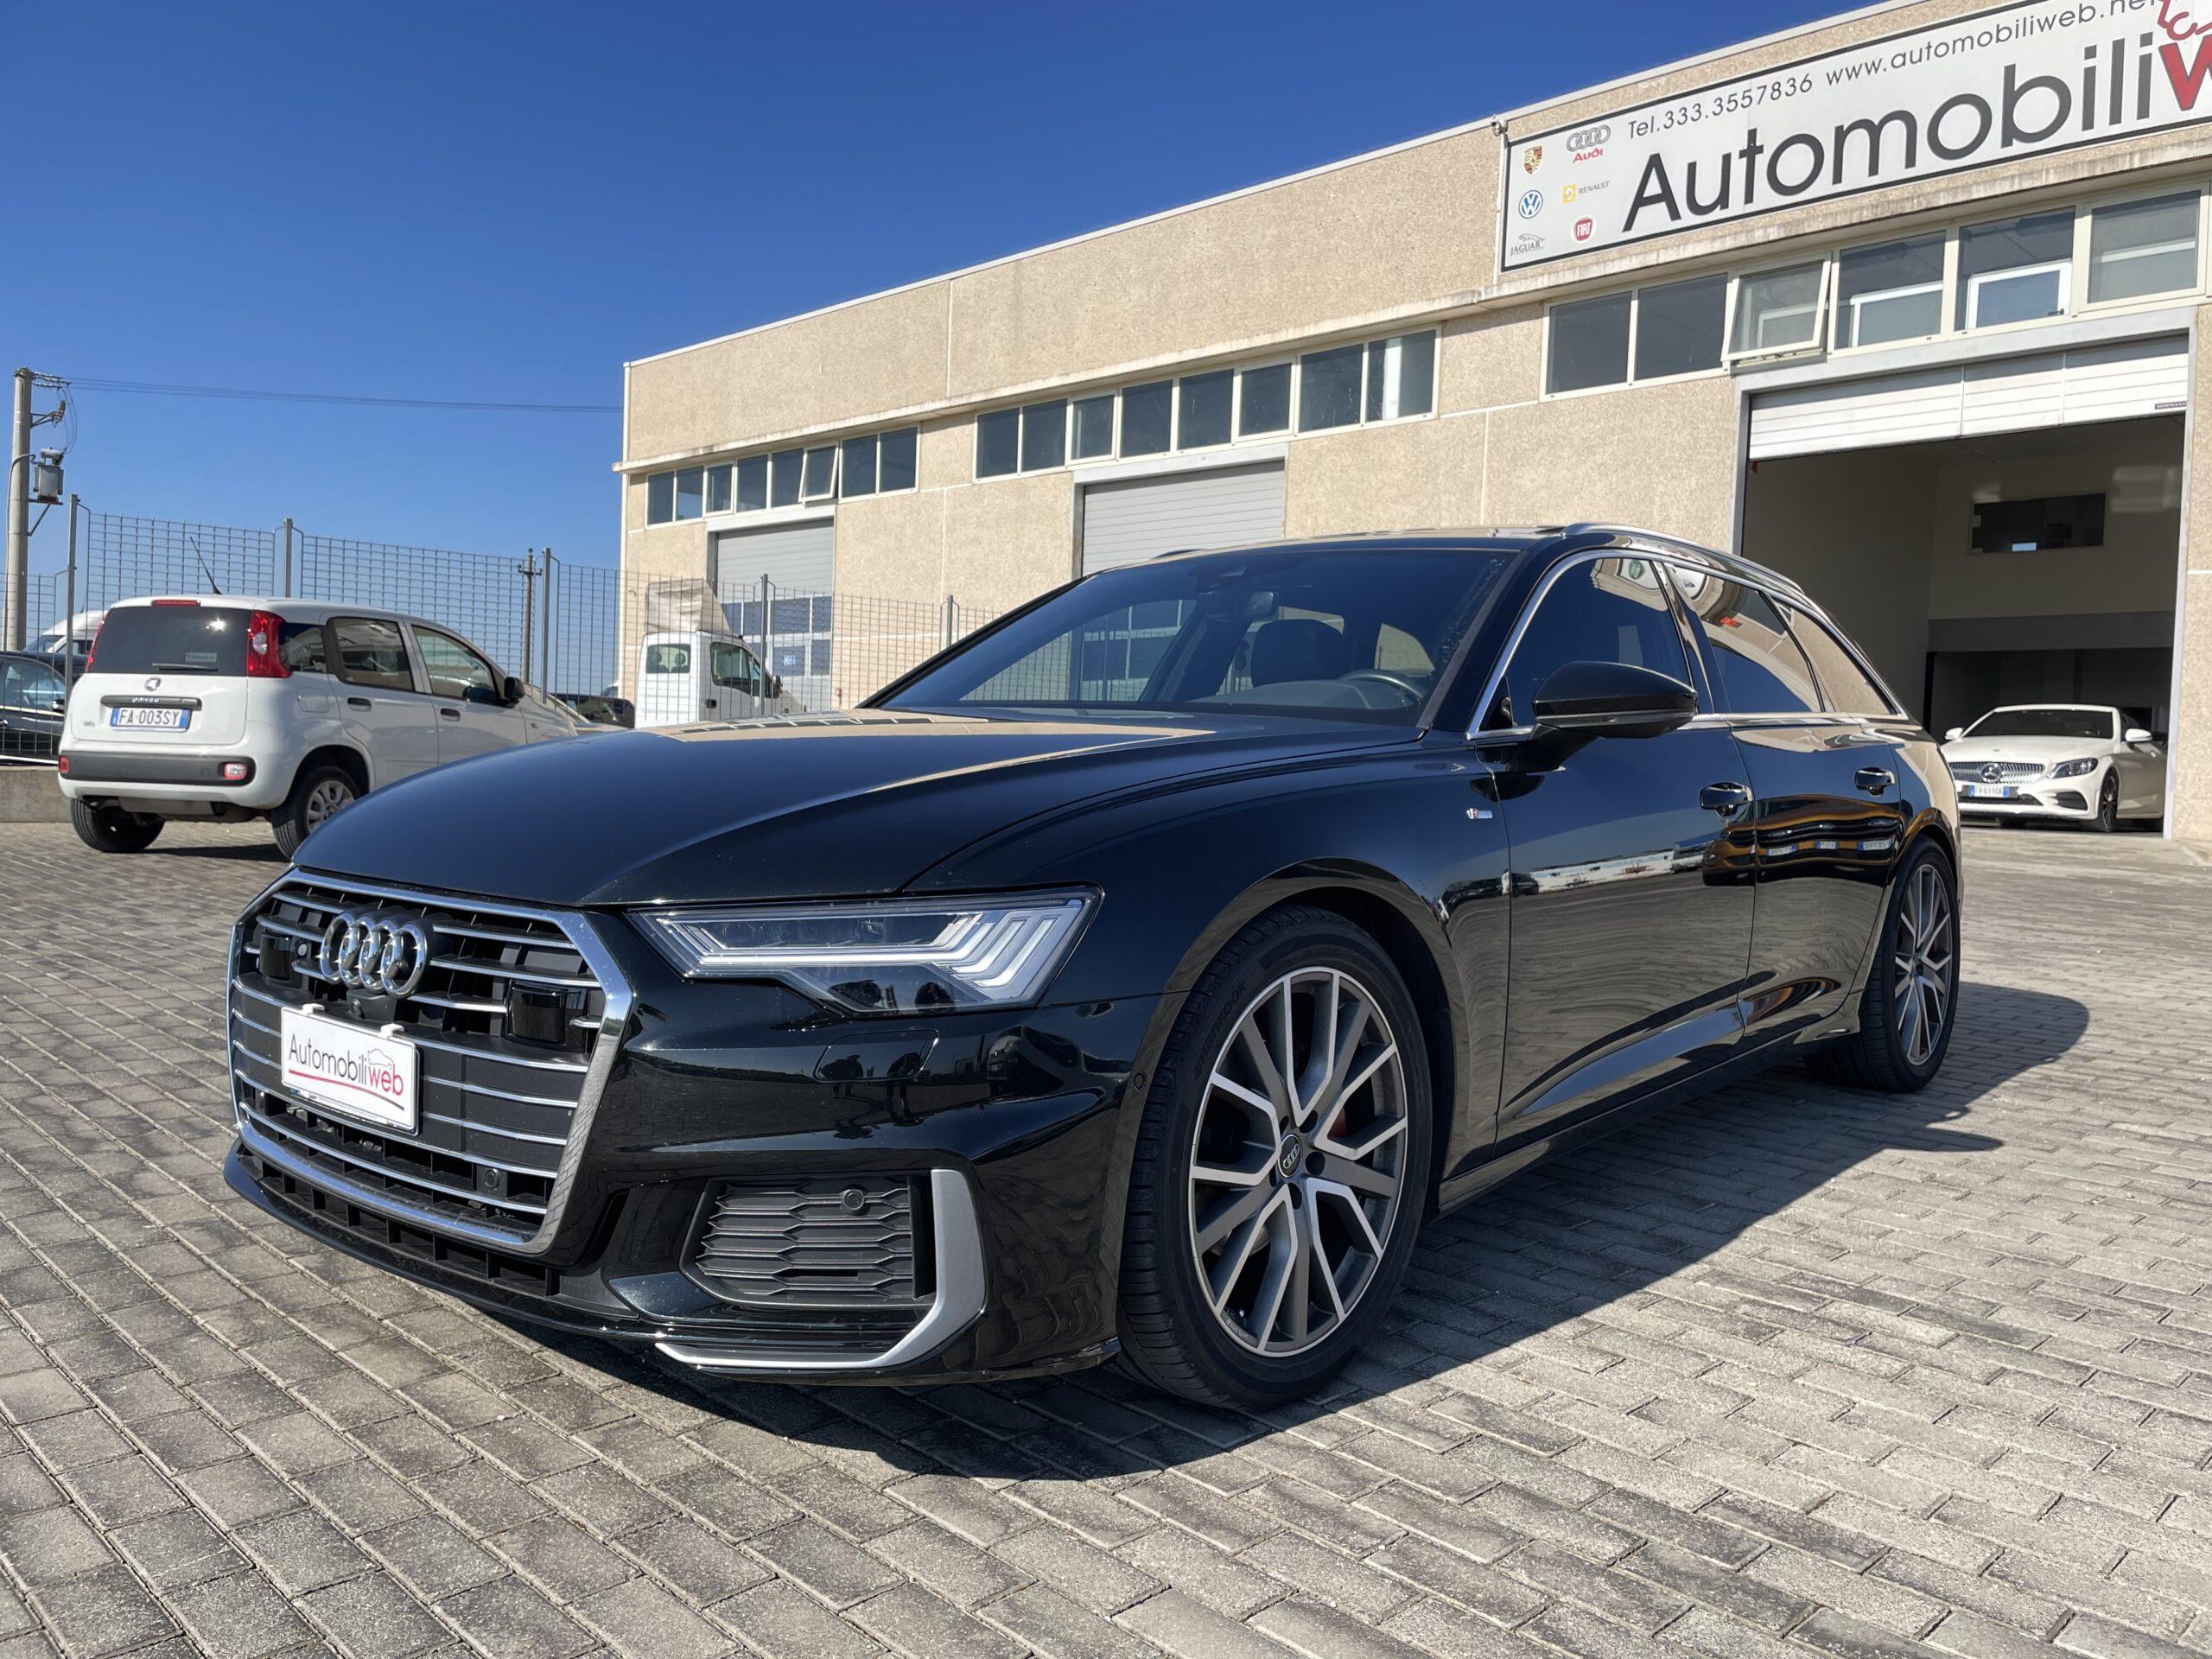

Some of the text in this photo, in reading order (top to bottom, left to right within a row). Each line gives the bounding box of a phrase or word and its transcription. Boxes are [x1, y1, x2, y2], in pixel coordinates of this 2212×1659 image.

[1628, 0, 2156, 139] Tel.333.3557836 www.automobiliweb.ne
[1578, 181, 1610, 194] RENAULT
[1576, 222, 1592, 238] FIAT
[1510, 241, 1541, 256] JAGUAR
[138, 710, 180, 726] 003SY
